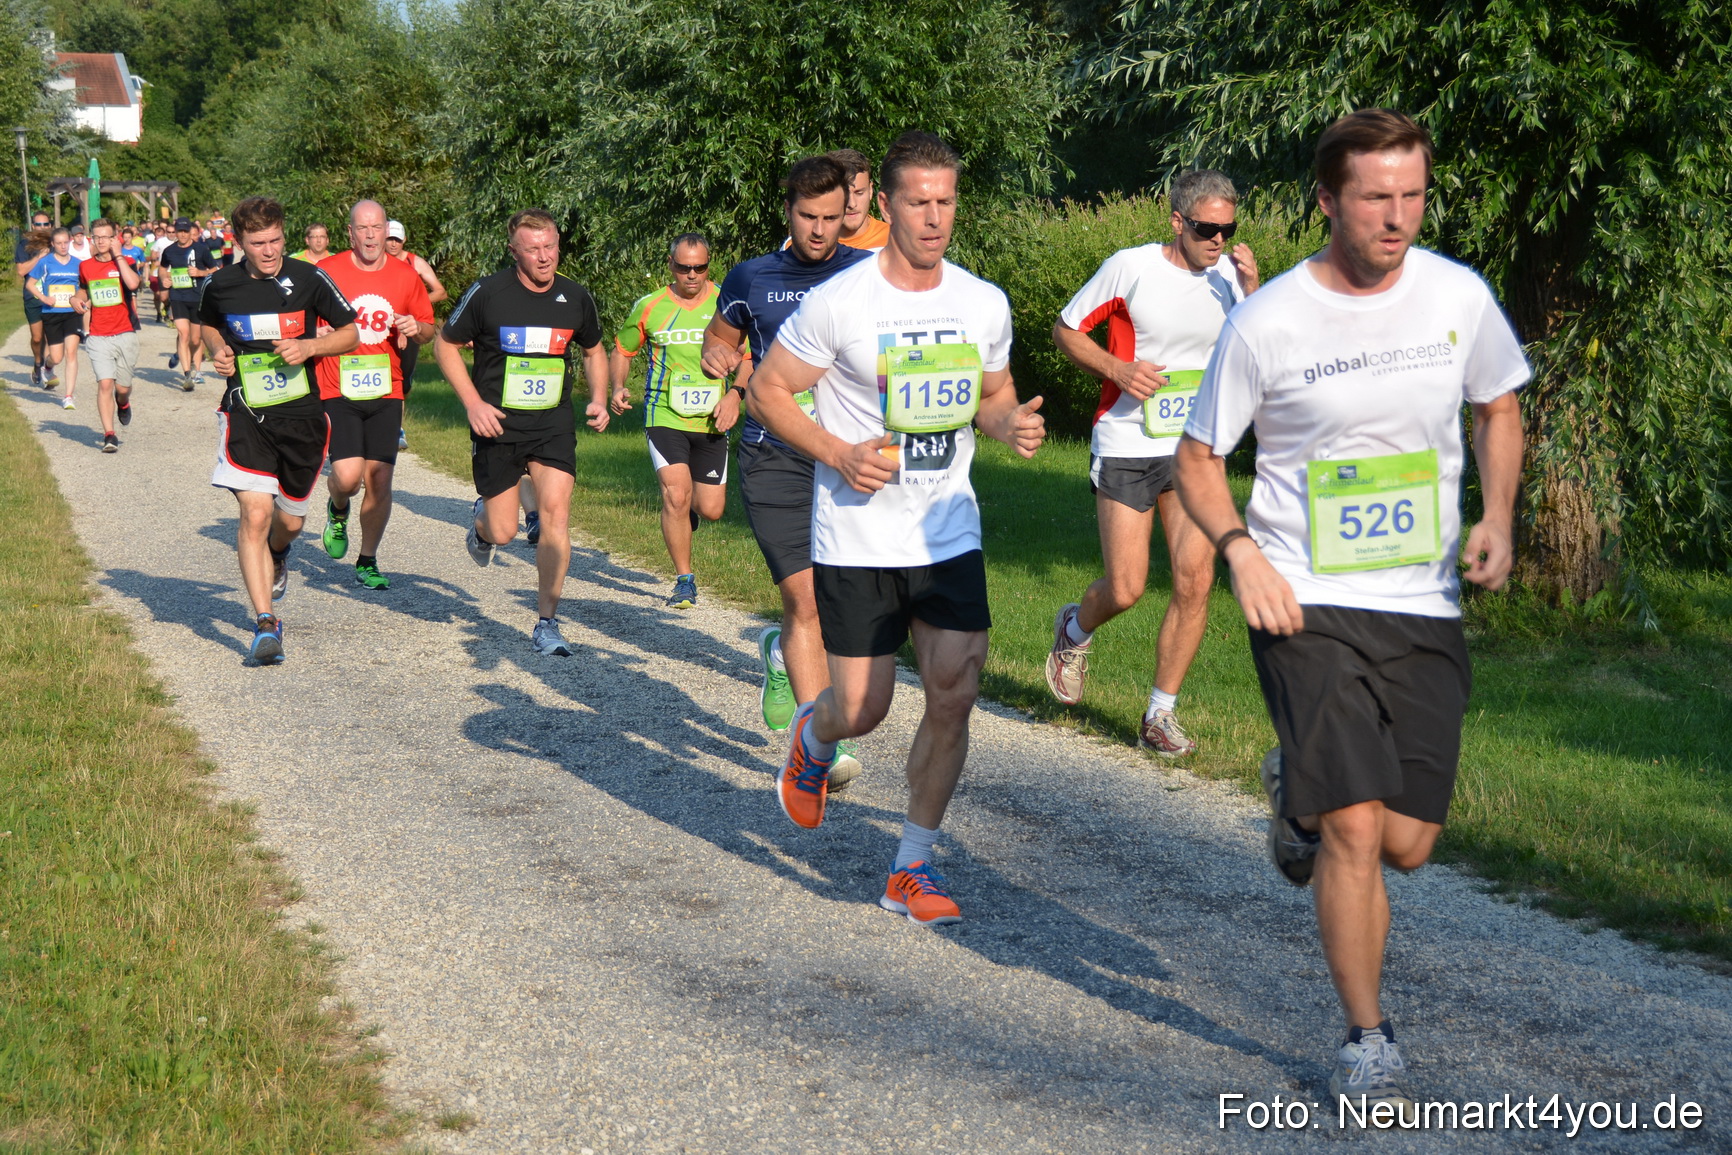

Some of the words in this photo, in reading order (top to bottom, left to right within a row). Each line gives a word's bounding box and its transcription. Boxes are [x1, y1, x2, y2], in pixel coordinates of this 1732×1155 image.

[173, 275, 189, 283] 1140
[93, 288, 119, 300] 1169
[354, 306, 389, 332] 48
[876, 320, 890, 328] DIE
[893, 319, 913, 327] NEUE
[916, 317, 964, 325] WOHNFORMEL
[1303, 341, 1451, 385] globalconcepts
[262, 372, 288, 391] 39
[351, 372, 382, 388] 546
[522, 379, 546, 396] 38
[680, 390, 712, 405] 137
[898, 378, 972, 409] 1158
[1338, 498, 1415, 541] 526
[1354, 546, 1379, 555] Stefan
[1380, 544, 1401, 553] Jäger
